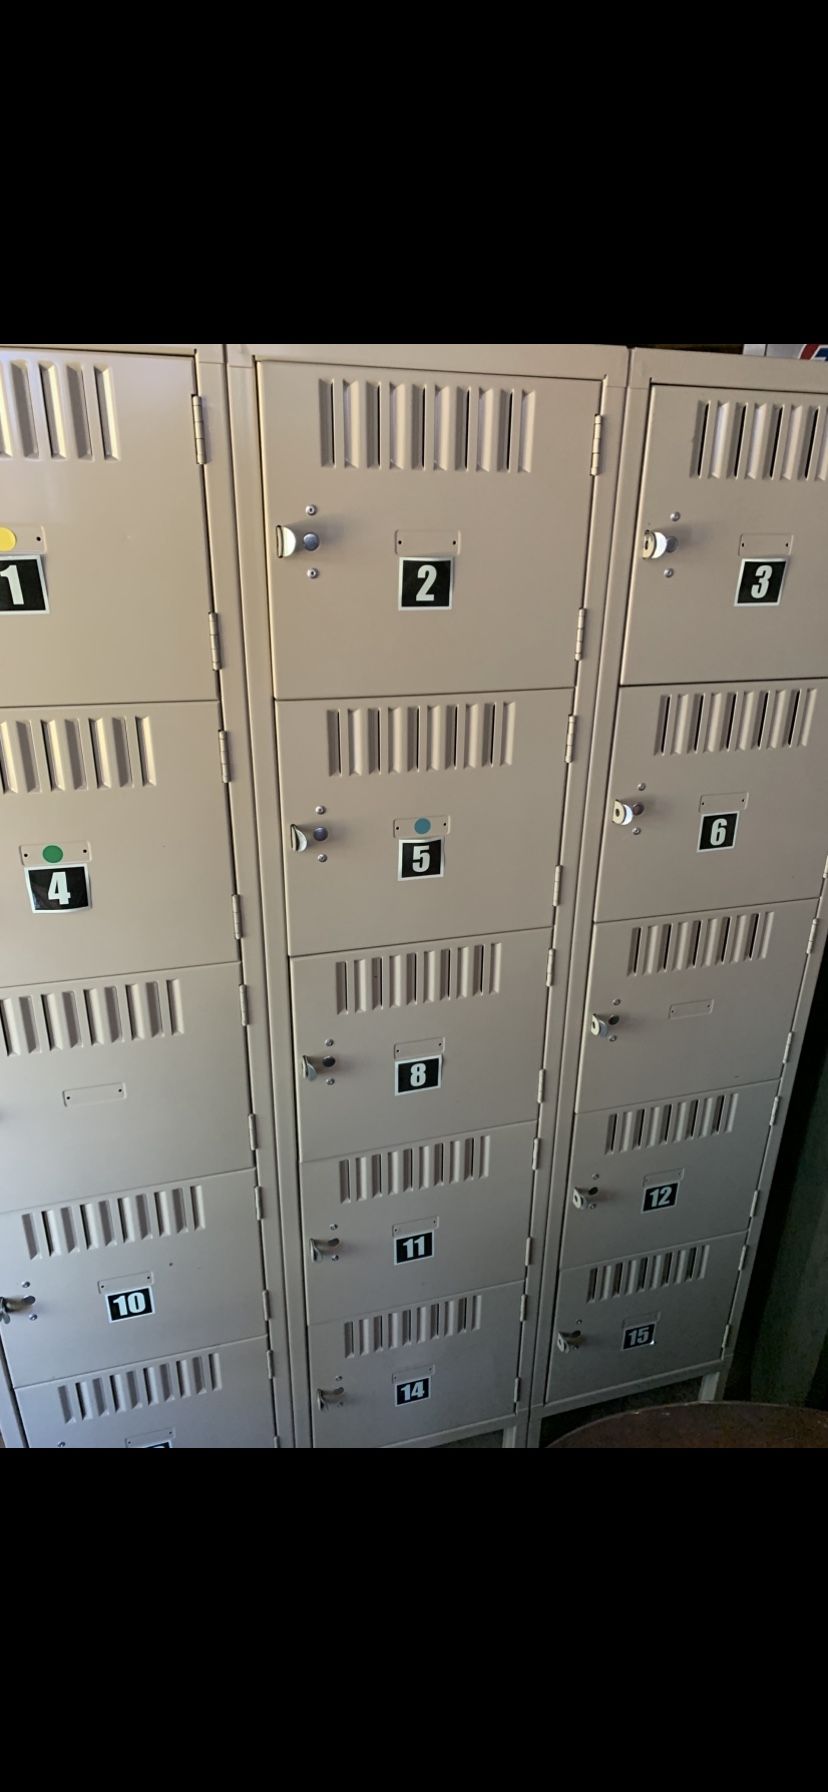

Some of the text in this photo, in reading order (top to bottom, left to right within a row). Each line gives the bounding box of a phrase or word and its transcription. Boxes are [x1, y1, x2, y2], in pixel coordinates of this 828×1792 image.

[0, 564, 24, 605] 1
[416, 564, 437, 601] 2
[751, 565, 772, 599] 3
[710, 819, 727, 845] 6
[412, 845, 430, 872] 5
[48, 872, 70, 905] 4
[410, 1063, 426, 1087] 8
[649, 1187, 672, 1207] 12
[403, 1236, 425, 1258] 11
[113, 1292, 146, 1316] 10
[629, 1327, 649, 1343] 15
[401, 1382, 425, 1400] 14
